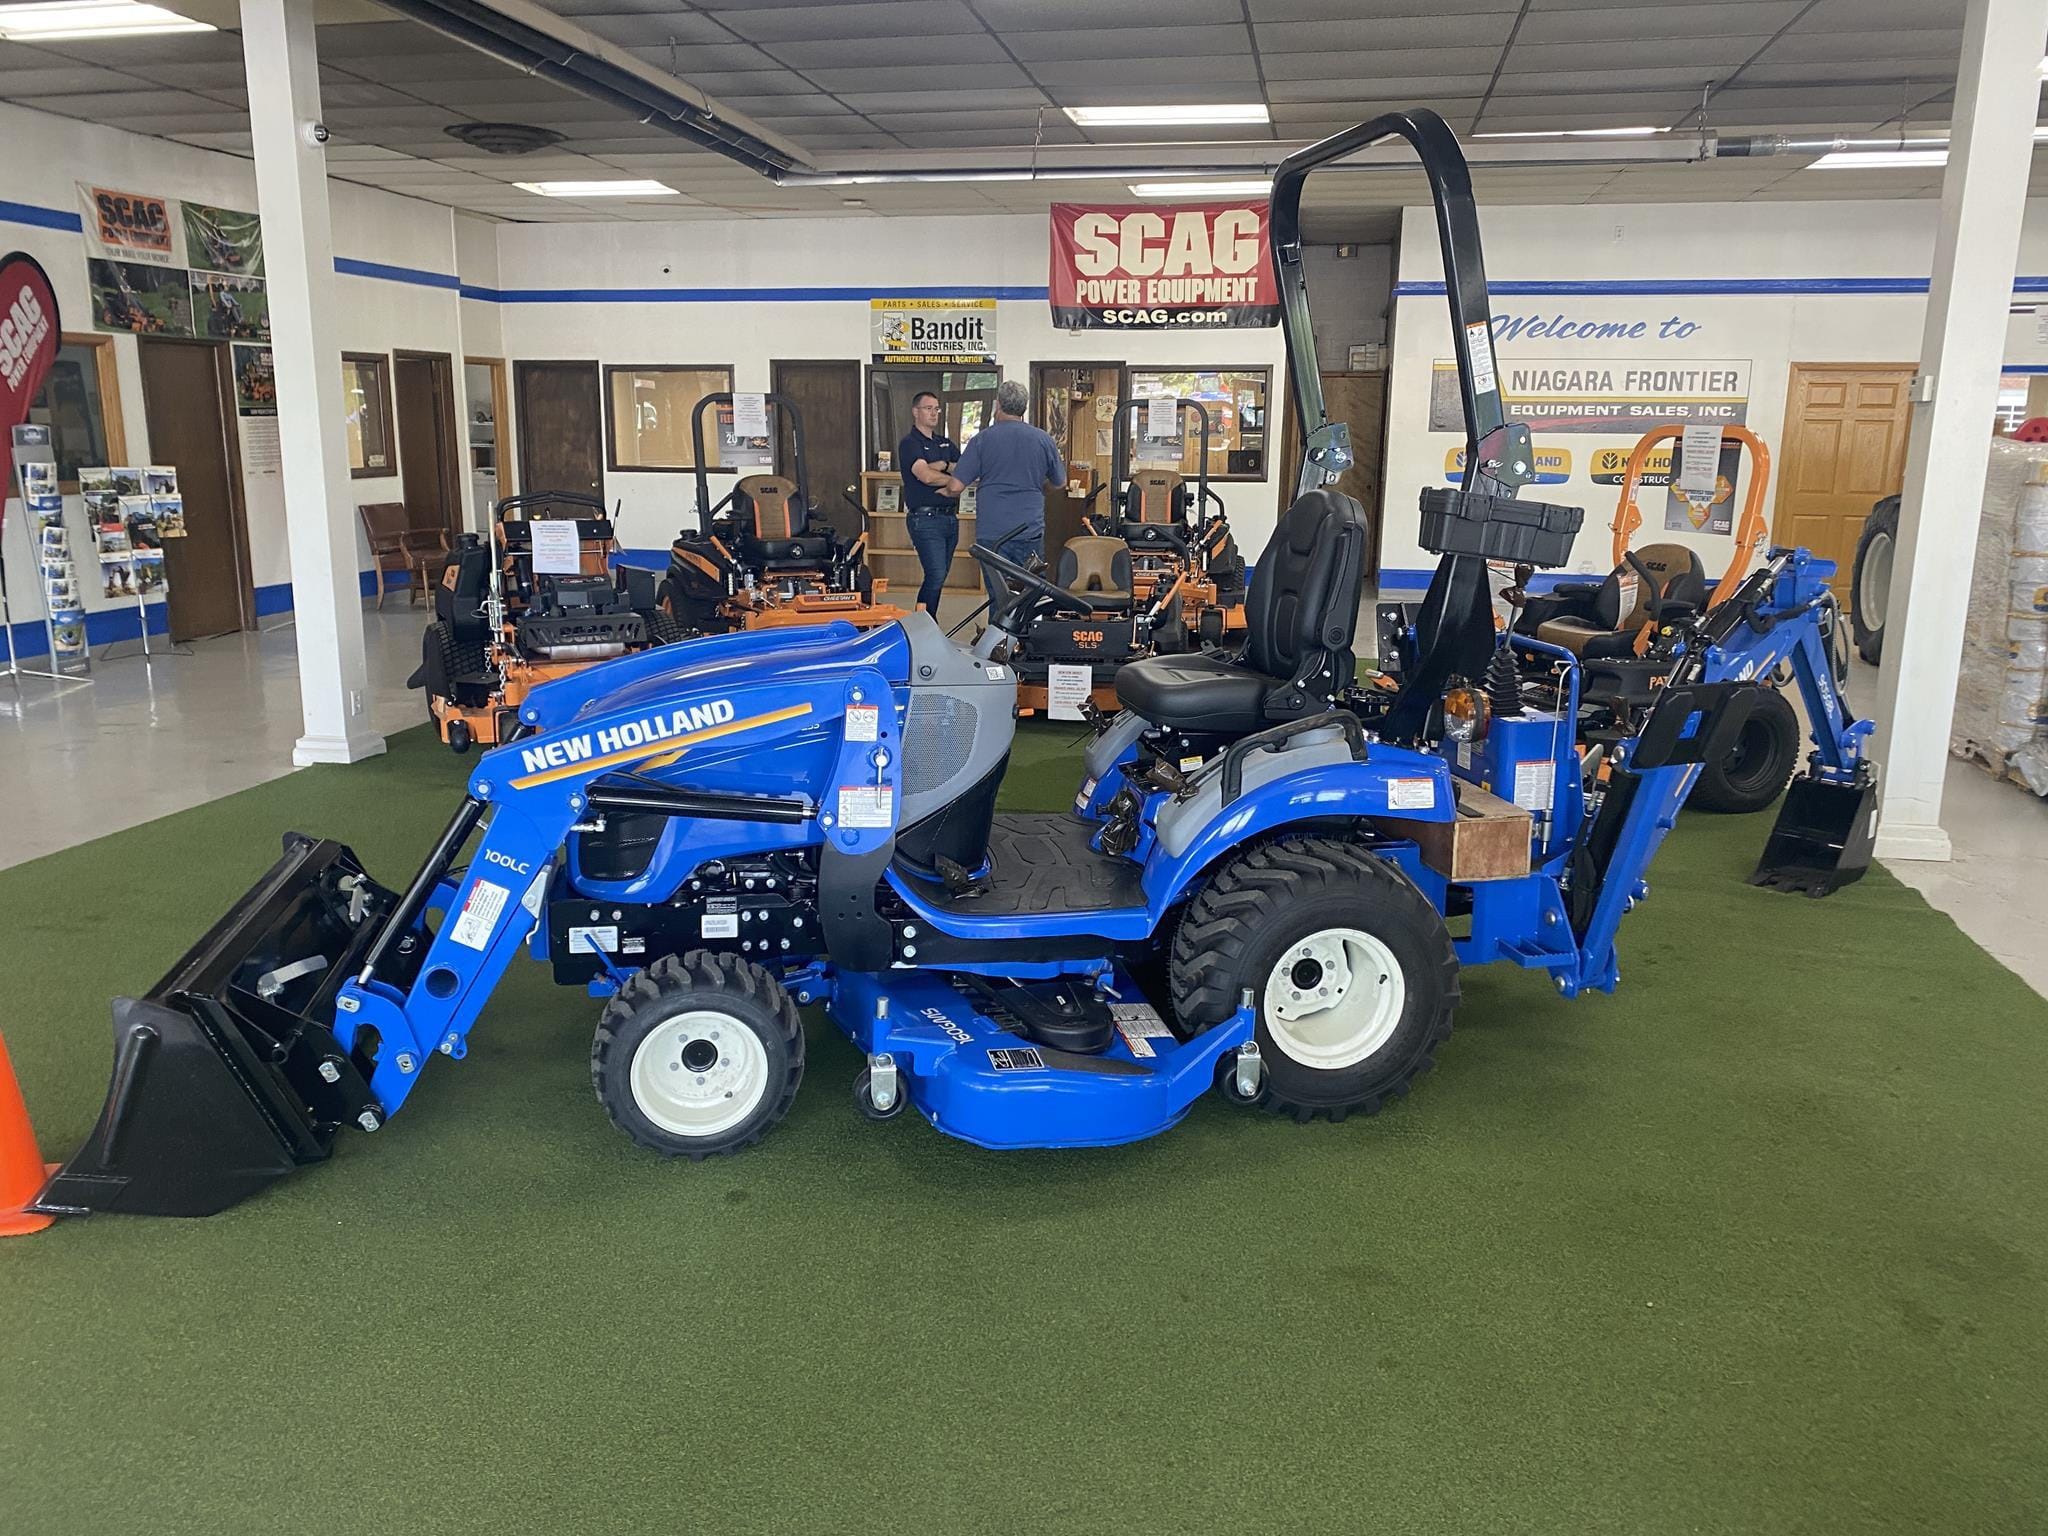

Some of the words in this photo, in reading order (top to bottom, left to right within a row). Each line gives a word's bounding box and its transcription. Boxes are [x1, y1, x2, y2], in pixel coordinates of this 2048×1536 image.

[97, 194, 166, 233] SCAG
[1074, 209, 1259, 276] SCAG
[1077, 279, 1141, 304] POWER
[1147, 277, 1258, 304] EQUIPMENT
[911, 317, 983, 340] Bandit
[1103, 309, 1228, 324] SCAG.com
[1489, 314, 1647, 342] Welcome
[1658, 316, 1702, 339] to
[0, 285, 42, 377] SCAG
[884, 355, 924, 363] AUTHORIZED
[925, 355, 950, 363] DEALER
[951, 355, 984, 363] LOCATION
[911, 341, 965, 352] INDUSTRIES,
[968, 341, 986, 351] INC.
[1511, 370, 1613, 391] NIAGARA
[1624, 371, 1738, 392] FRONTIER
[1510, 405, 1622, 416] EQUIPMENT
[1630, 405, 1692, 418] SALES,
[1698, 405, 1736, 416] INC.
[1072, 631, 1103, 642] SCAG
[1078, 641, 1097, 649] SLS
[521, 734, 593, 773] NEW
[597, 699, 735, 753] HOLLAND
[484, 848, 530, 875] 100LC
[920, 1007, 975, 1045] 160GMS
